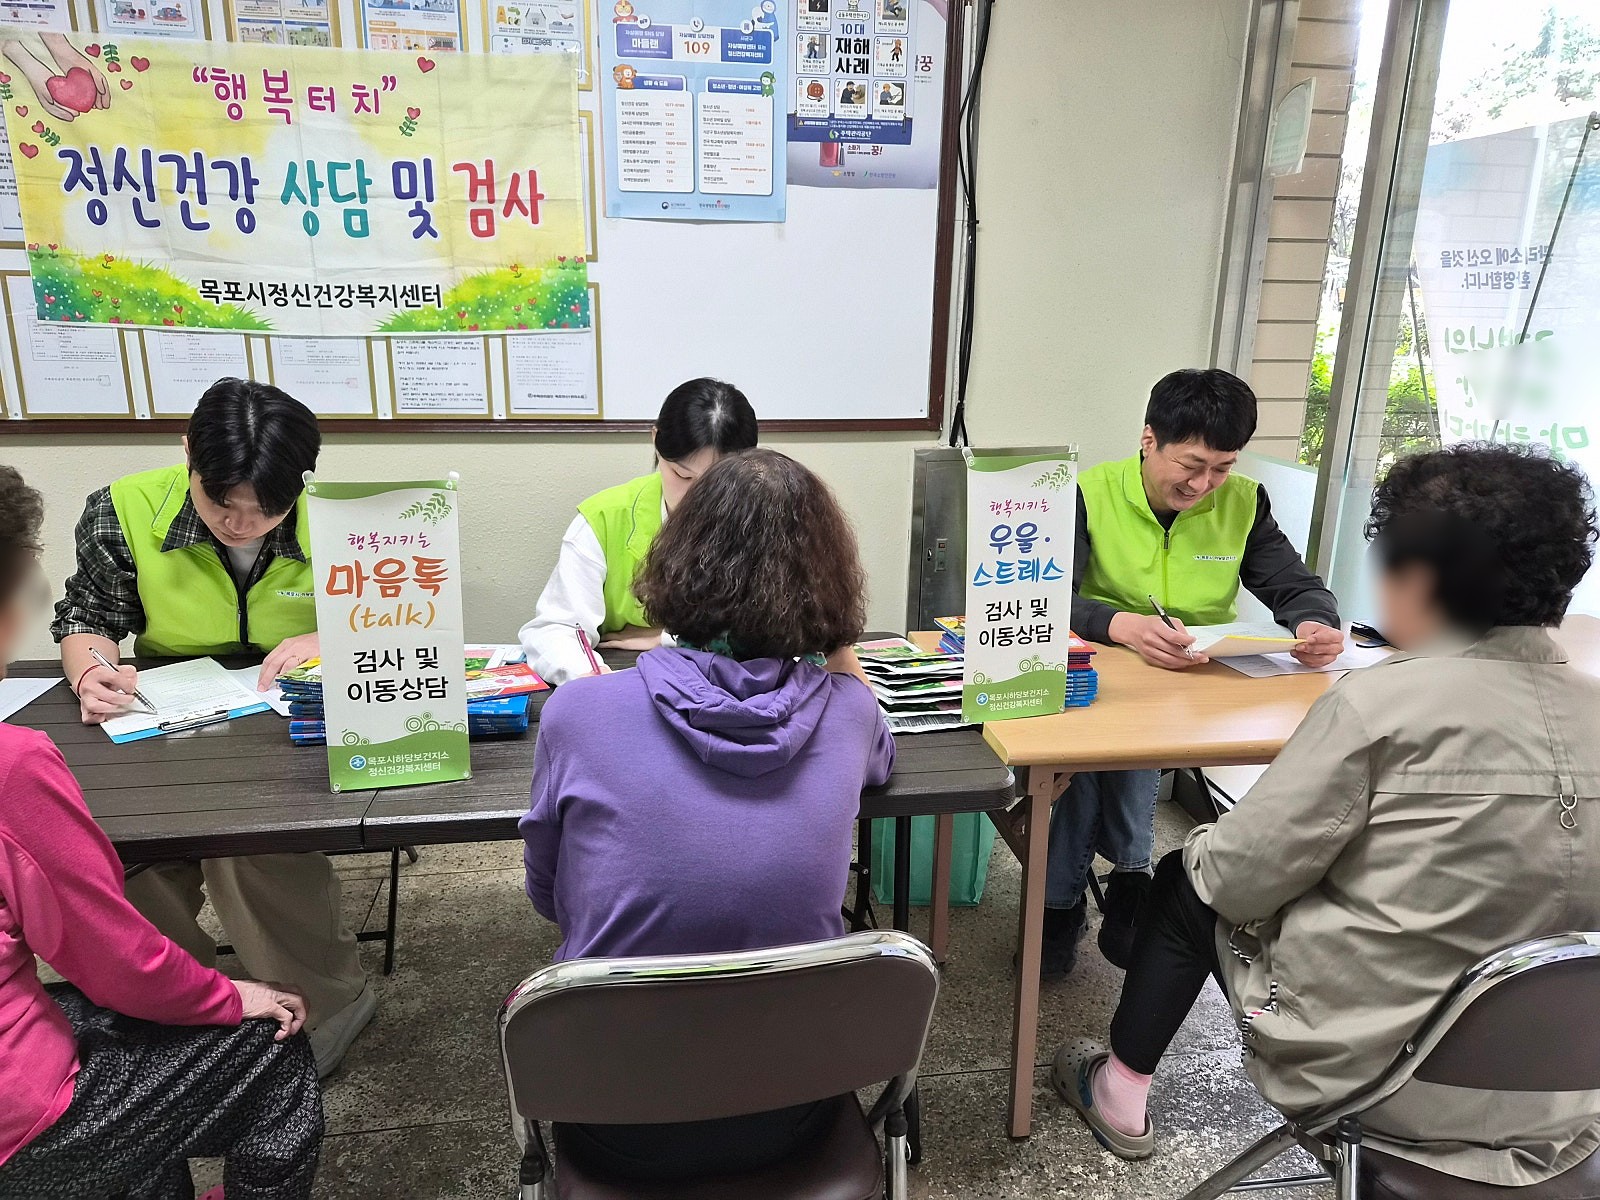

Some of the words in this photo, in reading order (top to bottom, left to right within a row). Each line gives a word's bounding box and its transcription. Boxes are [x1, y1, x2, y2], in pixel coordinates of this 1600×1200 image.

[684, 40, 711, 54] 109
[835, 37, 870, 55] 재해
[835, 57, 870, 74] 사례
[58, 146, 260, 235] 정신건강
[280, 158, 373, 238] 상담
[391, 157, 439, 240] 및
[453, 158, 545, 239] 검사
[199, 278, 443, 309] 목포시정신건강복지센터
[989, 499, 1051, 518] 행복지키는
[347, 531, 431, 554] 행복지키는
[325, 555, 450, 600] 마음톡
[972, 556, 1066, 587] 스트레스
[348, 601, 436, 633] (talk)
[985, 599, 1023, 623] 검사
[1030, 597, 1048, 619] 및
[979, 622, 1054, 648] 이동상담
[352, 647, 405, 674] 검사
[415, 646, 439, 669] 및
[347, 675, 449, 704] 이동상담
[367, 751, 450, 766] 목포시하당보건지소
[368, 761, 442, 777] 정신건강복지센터
